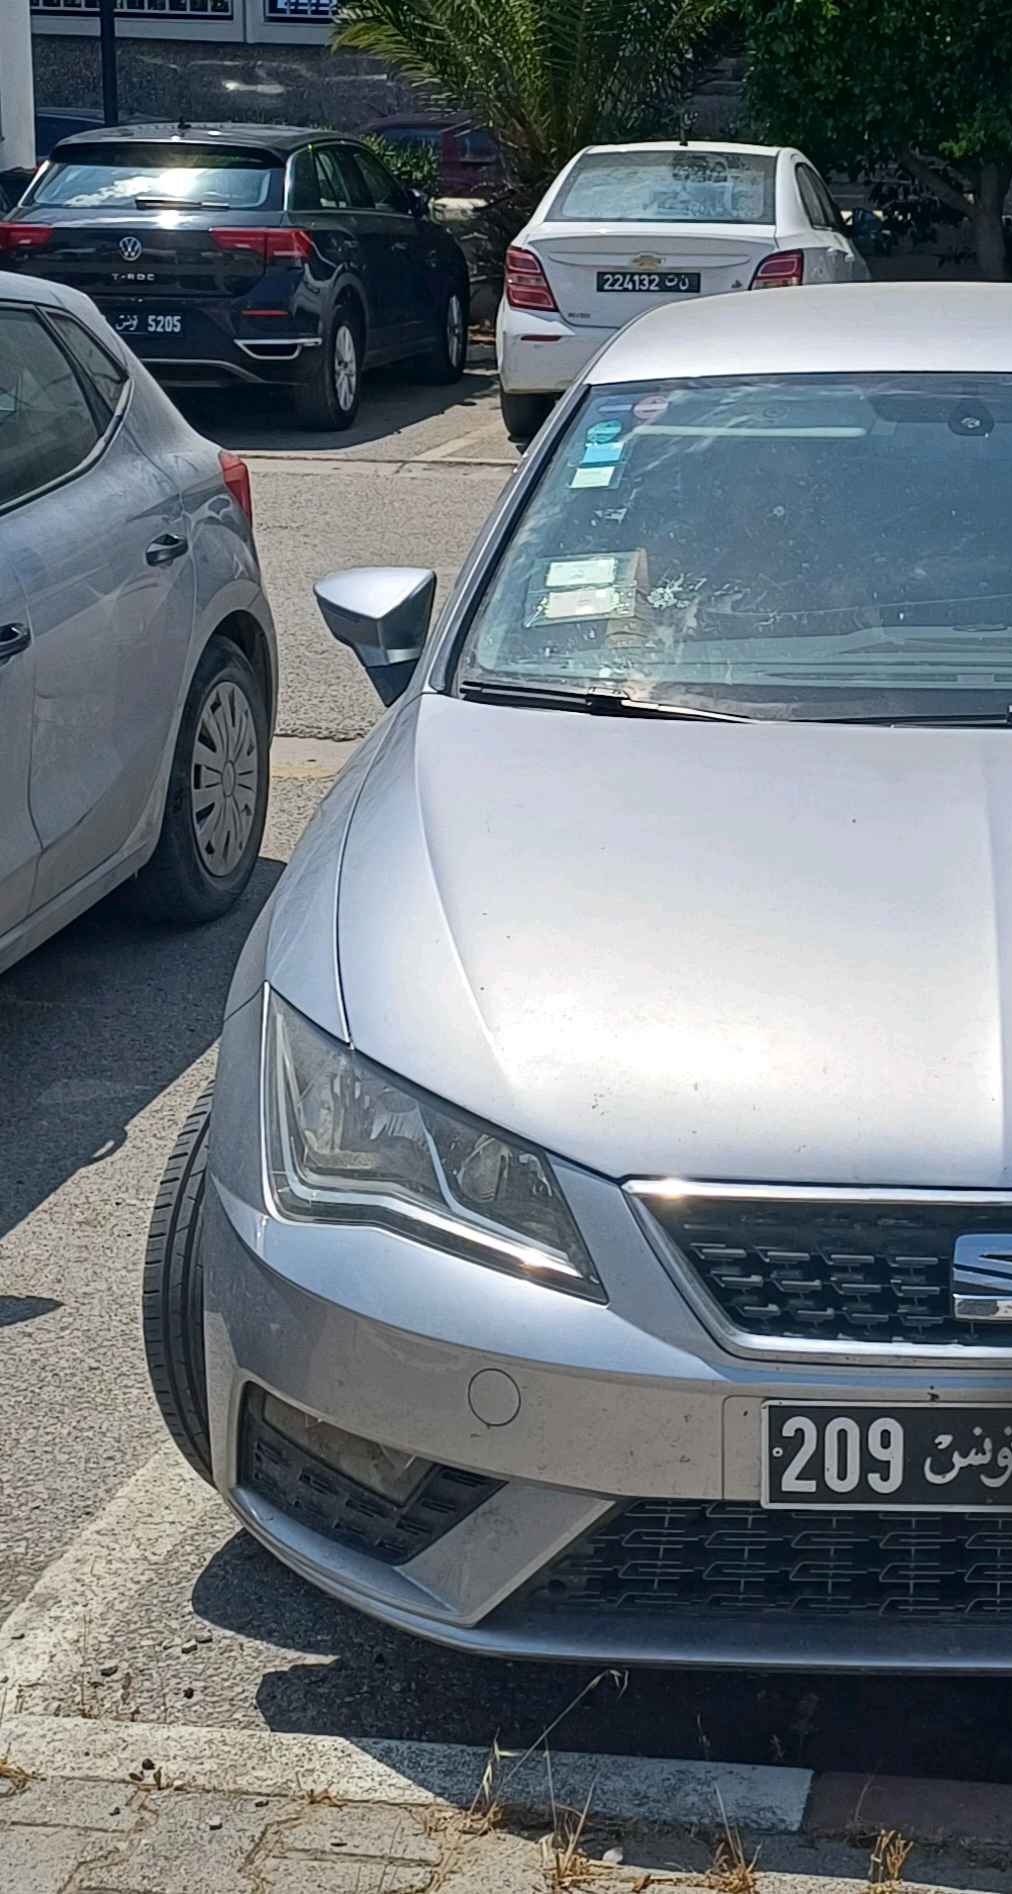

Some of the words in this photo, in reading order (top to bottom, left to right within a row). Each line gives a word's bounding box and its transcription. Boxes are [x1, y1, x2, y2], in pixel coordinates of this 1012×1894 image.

[603, 274, 660, 291] 224132
[147, 315, 182, 332] 5205
[781, 1415, 905, 1495] 209
